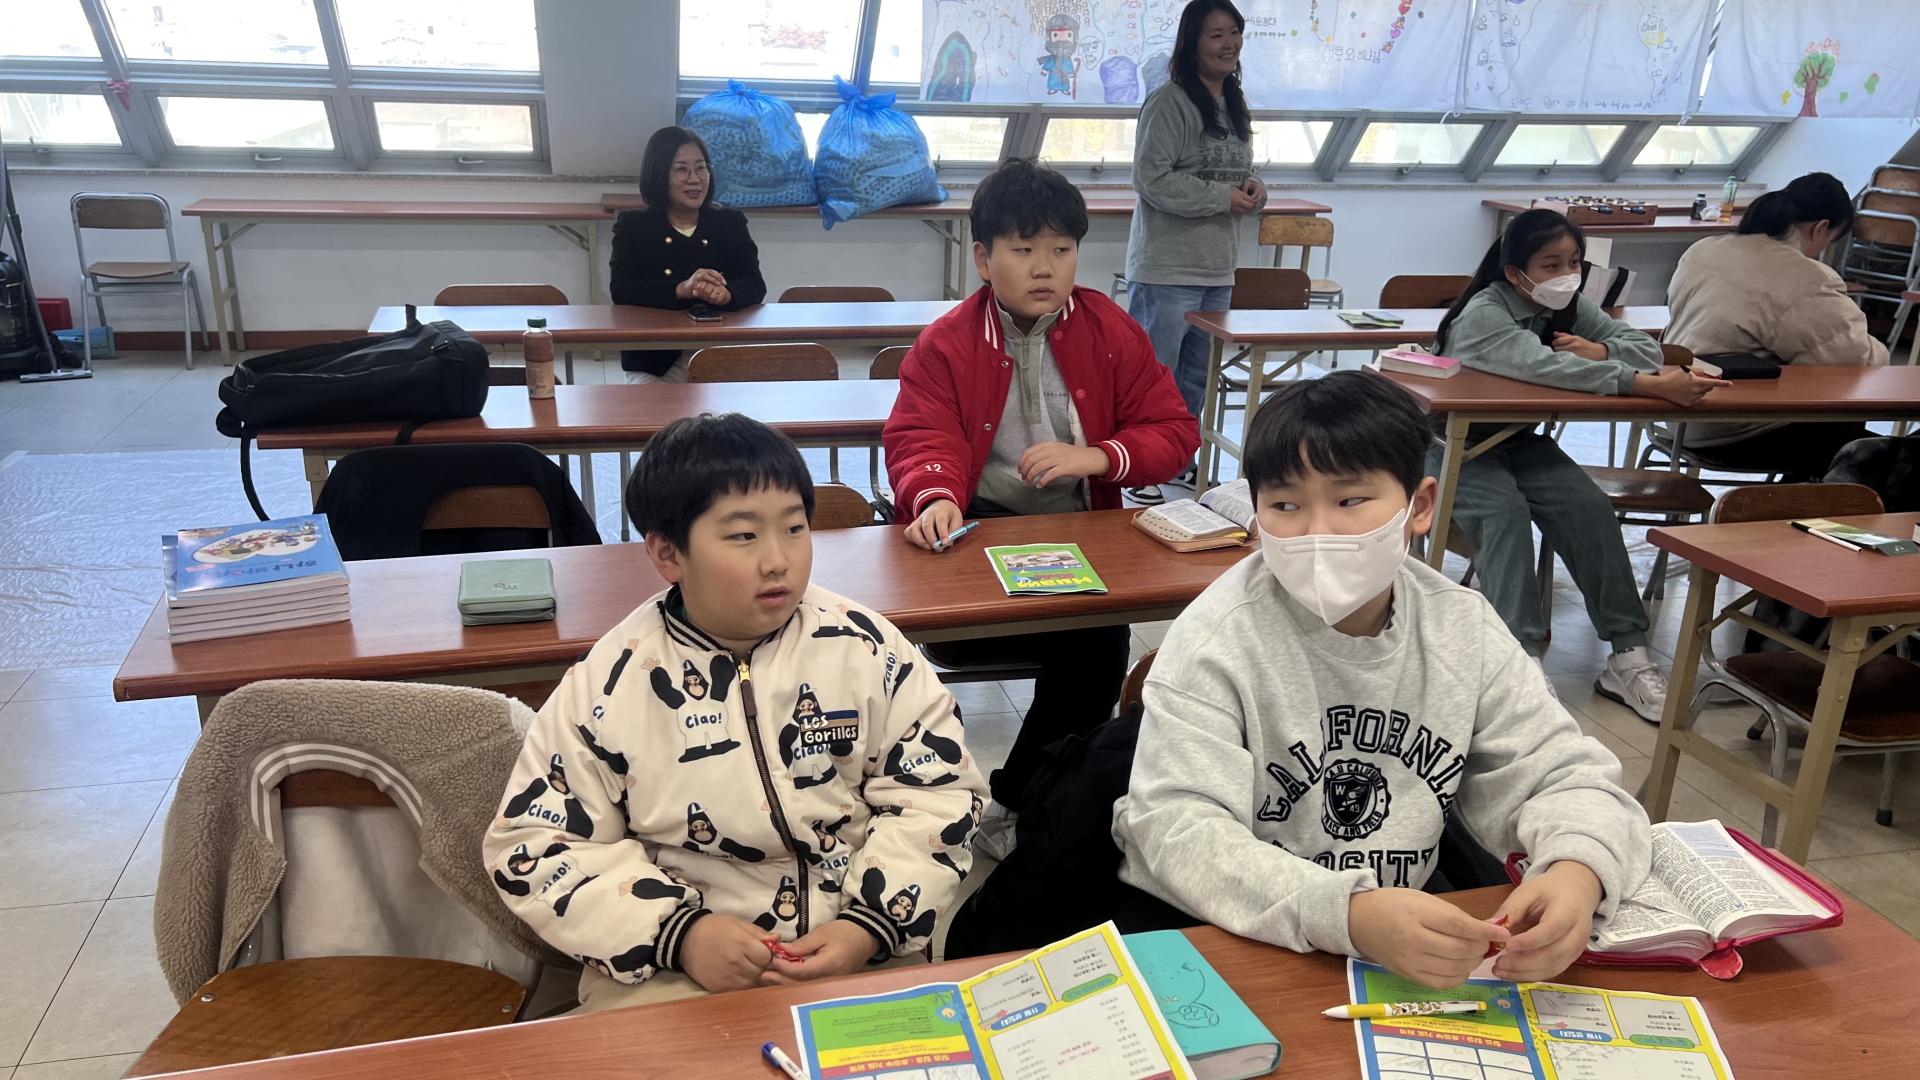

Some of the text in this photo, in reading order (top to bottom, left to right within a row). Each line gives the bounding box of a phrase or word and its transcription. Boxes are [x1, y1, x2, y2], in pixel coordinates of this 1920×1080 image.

[924, 463, 943, 473] 12
[685, 712, 722, 729] Ciao!
[803, 714, 829, 730] Les
[902, 751, 937, 774] Ciao!
[1257, 704, 1467, 824] CALFORNI
[1335, 784, 1346, 796] W
[527, 803, 567, 827] Ciao!
[1349, 804, 1360, 813] 49
[1324, 810, 1383, 836] RACK AND FIELD
[1000, 1007, 1039, 1027] 11월 생일자
[1560, 1030, 1584, 1039] 생일자
